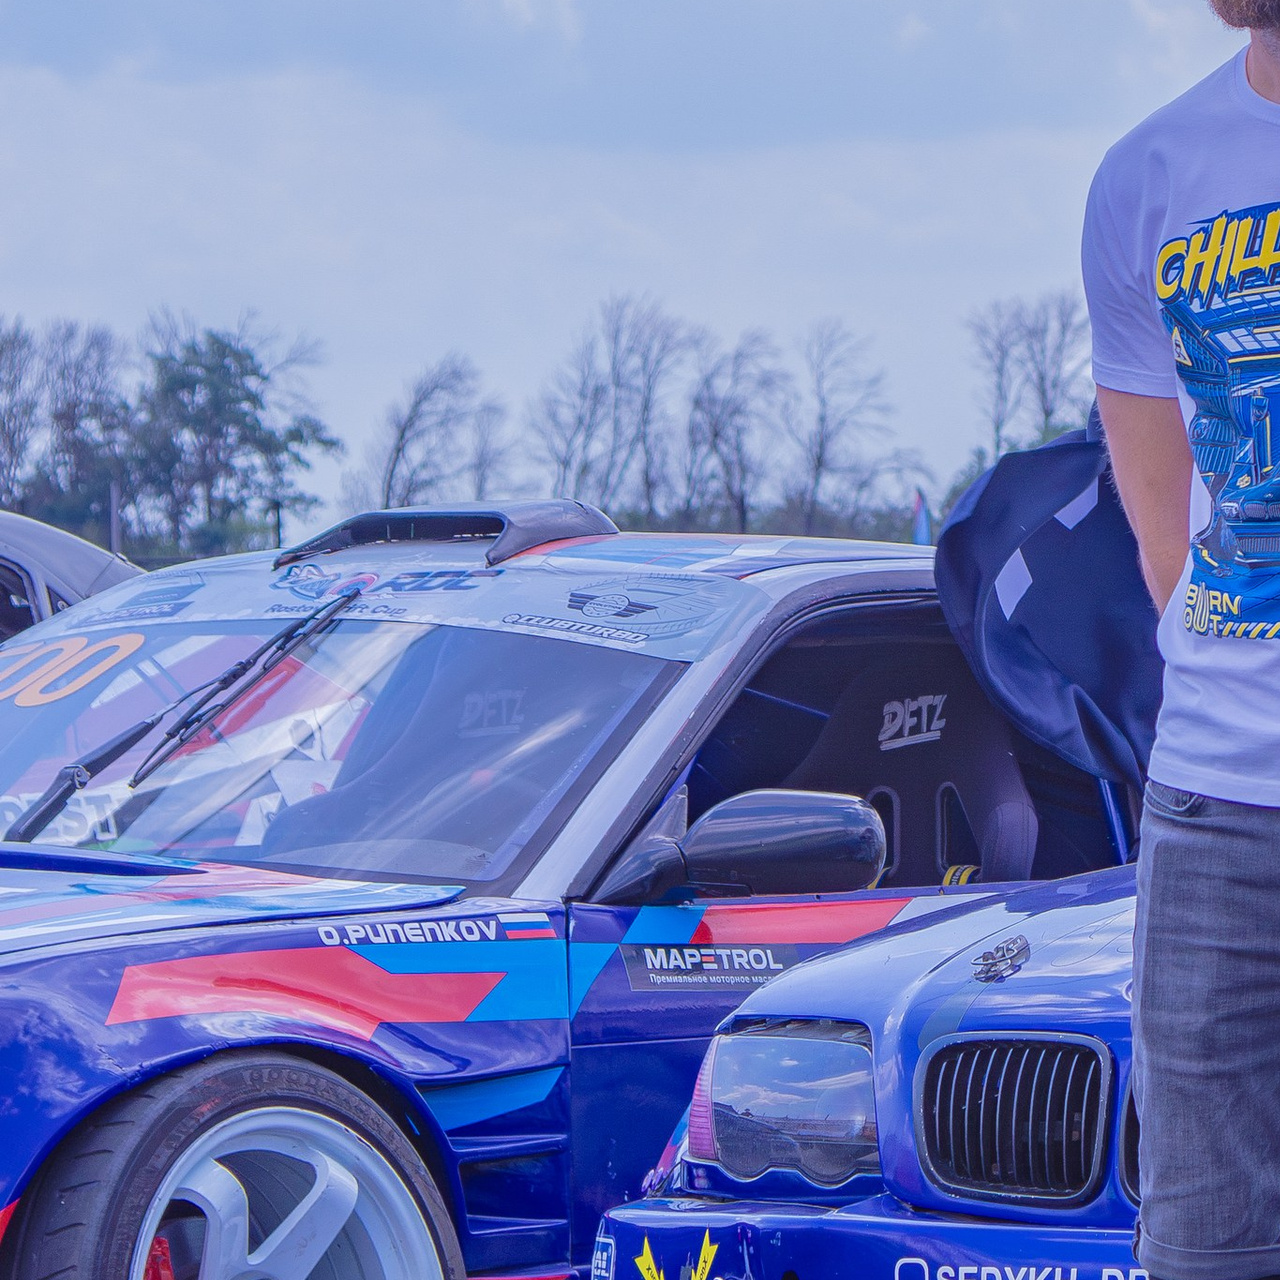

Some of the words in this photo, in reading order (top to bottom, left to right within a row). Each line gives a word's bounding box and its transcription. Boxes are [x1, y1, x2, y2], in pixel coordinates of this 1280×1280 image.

[371, 604, 408, 616] Cup
[1185, 583, 1242, 617] BURN
[518, 615, 649, 643] CLUBTURBO
[644, 949, 783, 969] MAPETROL
[650, 973, 707, 985] Премиальное
[710, 975, 750, 984] моторное
